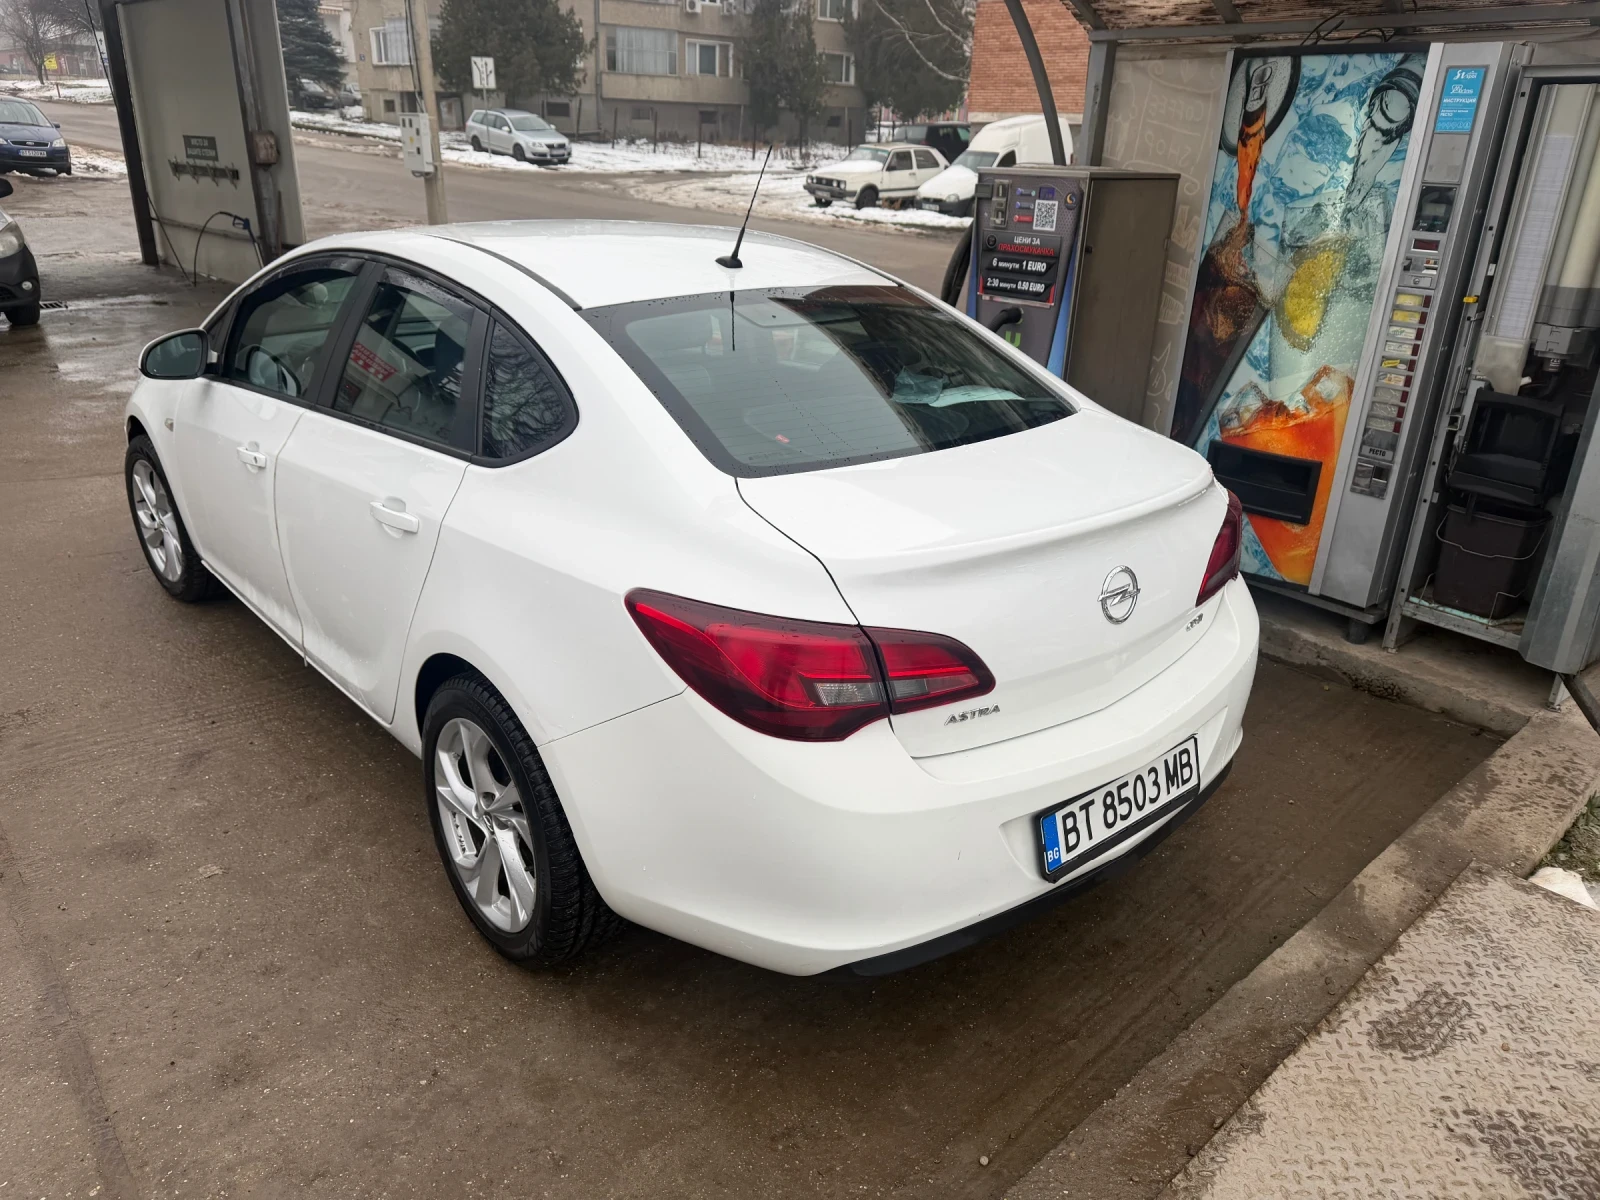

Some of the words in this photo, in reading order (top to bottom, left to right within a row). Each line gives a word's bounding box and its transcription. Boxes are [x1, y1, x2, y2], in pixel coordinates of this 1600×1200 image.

[1014, 236, 1031, 244] ЦЕНИ
[998, 243, 1054, 256] ПРАХОСМУКАЧКА
[992, 257, 998, 266] 6
[998, 261, 1020, 270] минути
[1022, 260, 1027, 270] 1
[1027, 261, 1047, 272] EURO
[987, 277, 999, 287] 2:30
[999, 281, 1016, 289] минути
[1017, 281, 1029, 290] 0.50
[1029, 282, 1045, 292] EURO
[1369, 448, 1386, 456] РЕСТО
[944, 703, 1000, 726] ASTRA
[1061, 798, 1095, 855] BT
[1102, 766, 1161, 829] 8503
[1164, 747, 1193, 796] MB
[1047, 847, 1060, 863] BG
